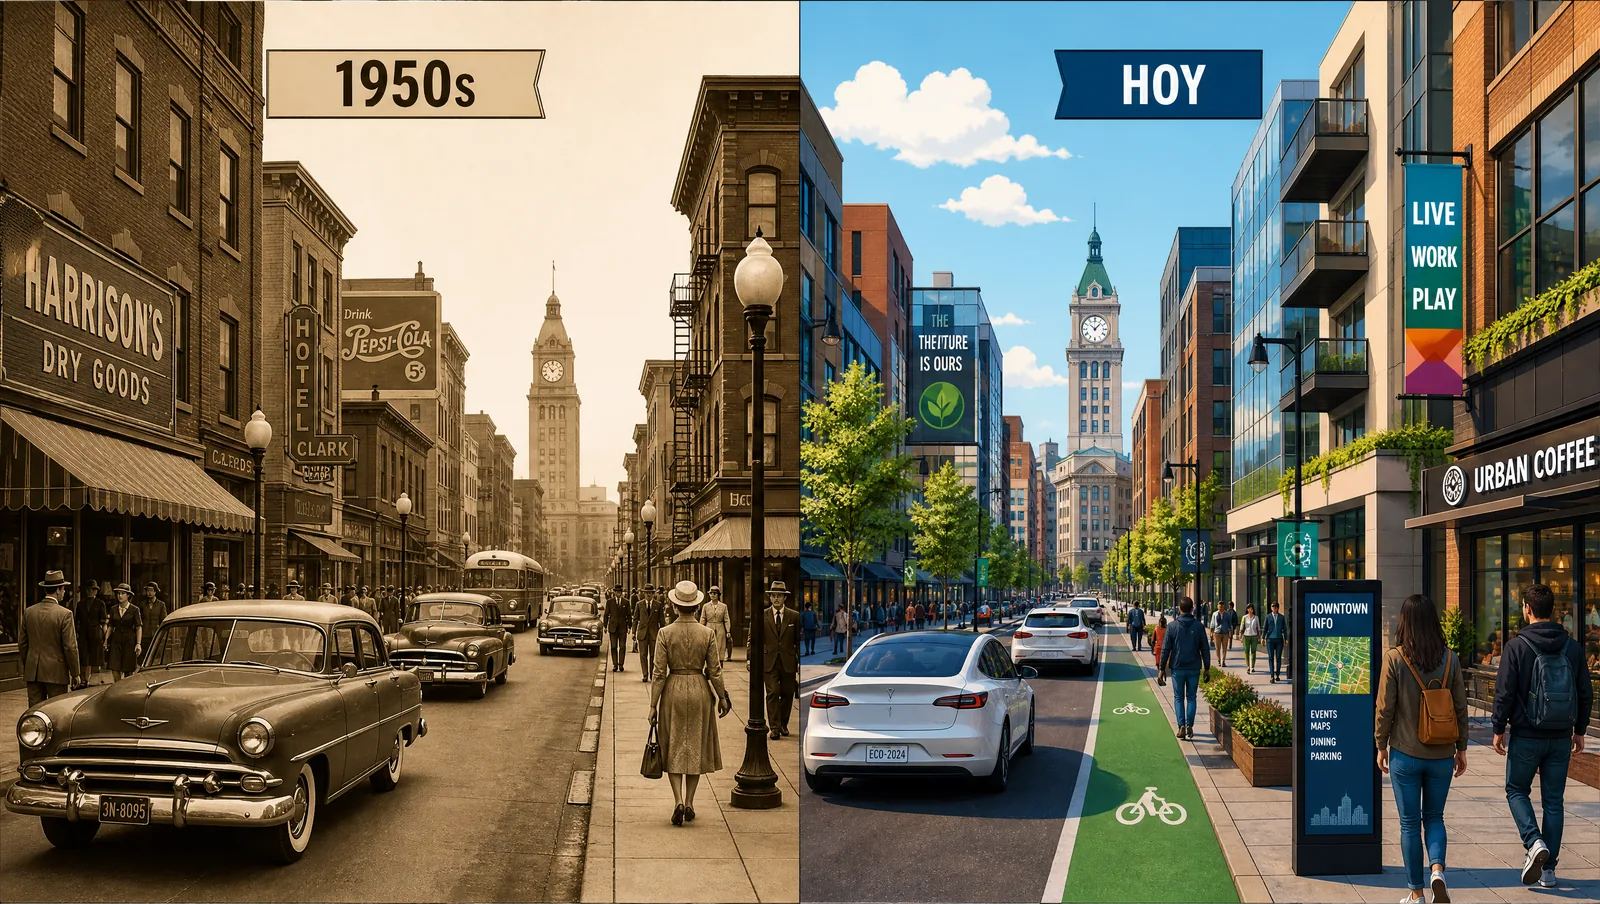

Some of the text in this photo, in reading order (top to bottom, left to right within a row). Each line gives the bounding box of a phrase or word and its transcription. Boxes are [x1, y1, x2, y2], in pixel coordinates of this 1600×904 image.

[1413, 201, 1456, 226] LIVE
[1411, 245, 1458, 268] WORK
[25, 247, 164, 362] HARRISON'S
[1412, 287, 1457, 311] PLAY
[931, 314, 949, 328] THE
[919, 355, 963, 372] IS OURS
[42, 340, 150, 405] DRY GOODS
[296, 318, 310, 432] HOTEL
[297, 441, 349, 457] CLARK
[1474, 435, 1596, 493] URBAN COFFEE
[1310, 602, 1368, 615] DOWNTOWN
[1310, 617, 1333, 629] INFO
[1310, 709, 1338, 719] EVENTS
[1310, 721, 1331, 731] MAPS
[1310, 737, 1337, 746] DINING
[869, 749, 906, 759] ECO-2024
[1310, 751, 1342, 761] PARKING
[102, 801, 146, 819] 3N-8095
